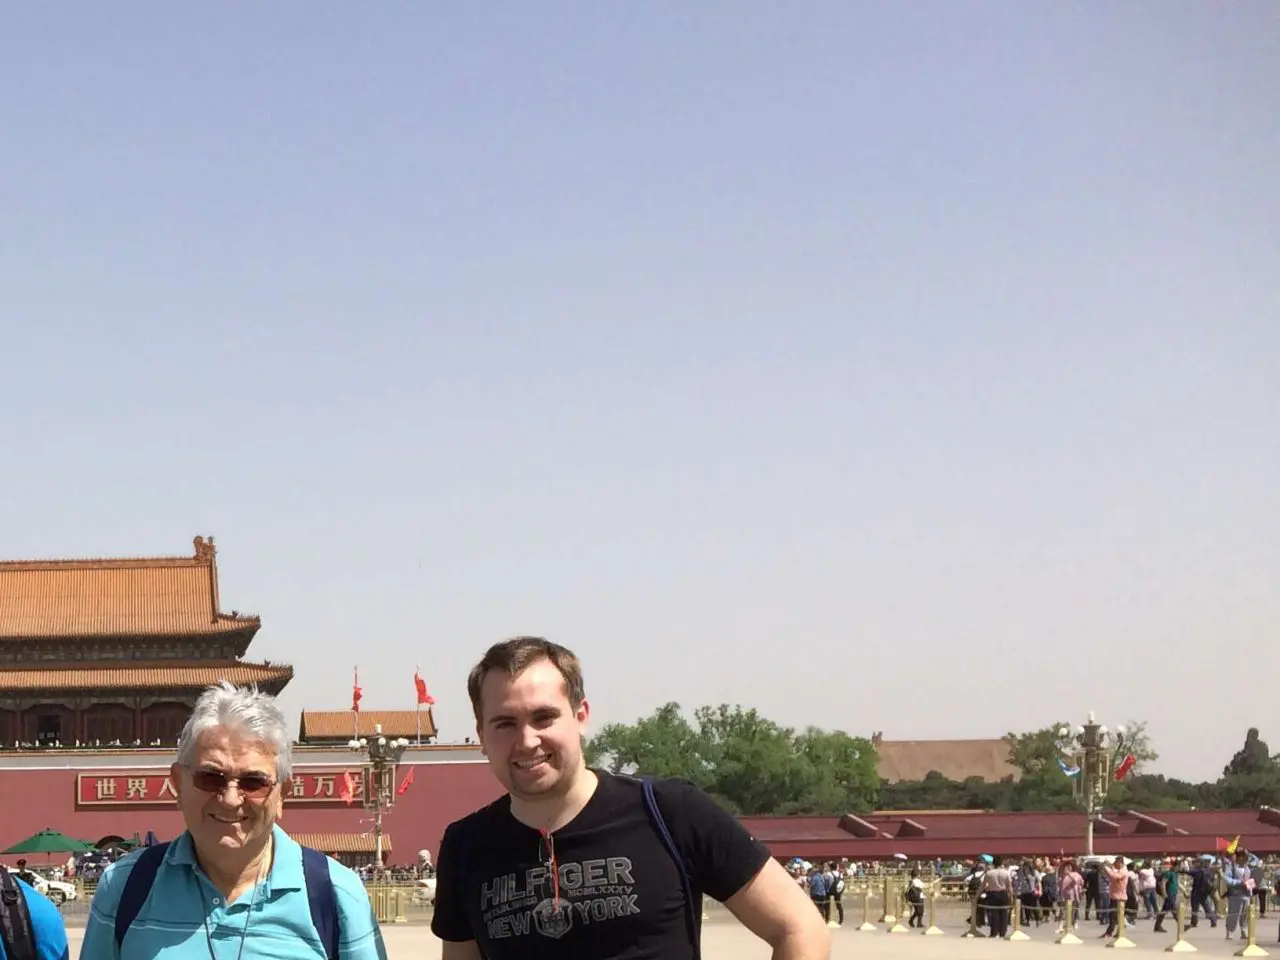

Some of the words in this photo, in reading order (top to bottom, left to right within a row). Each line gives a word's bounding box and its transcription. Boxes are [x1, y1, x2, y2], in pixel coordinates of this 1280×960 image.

[96, 778, 178, 799] 世界人
[486, 911, 531, 939] NEW
[574, 894, 641, 924] YORK
